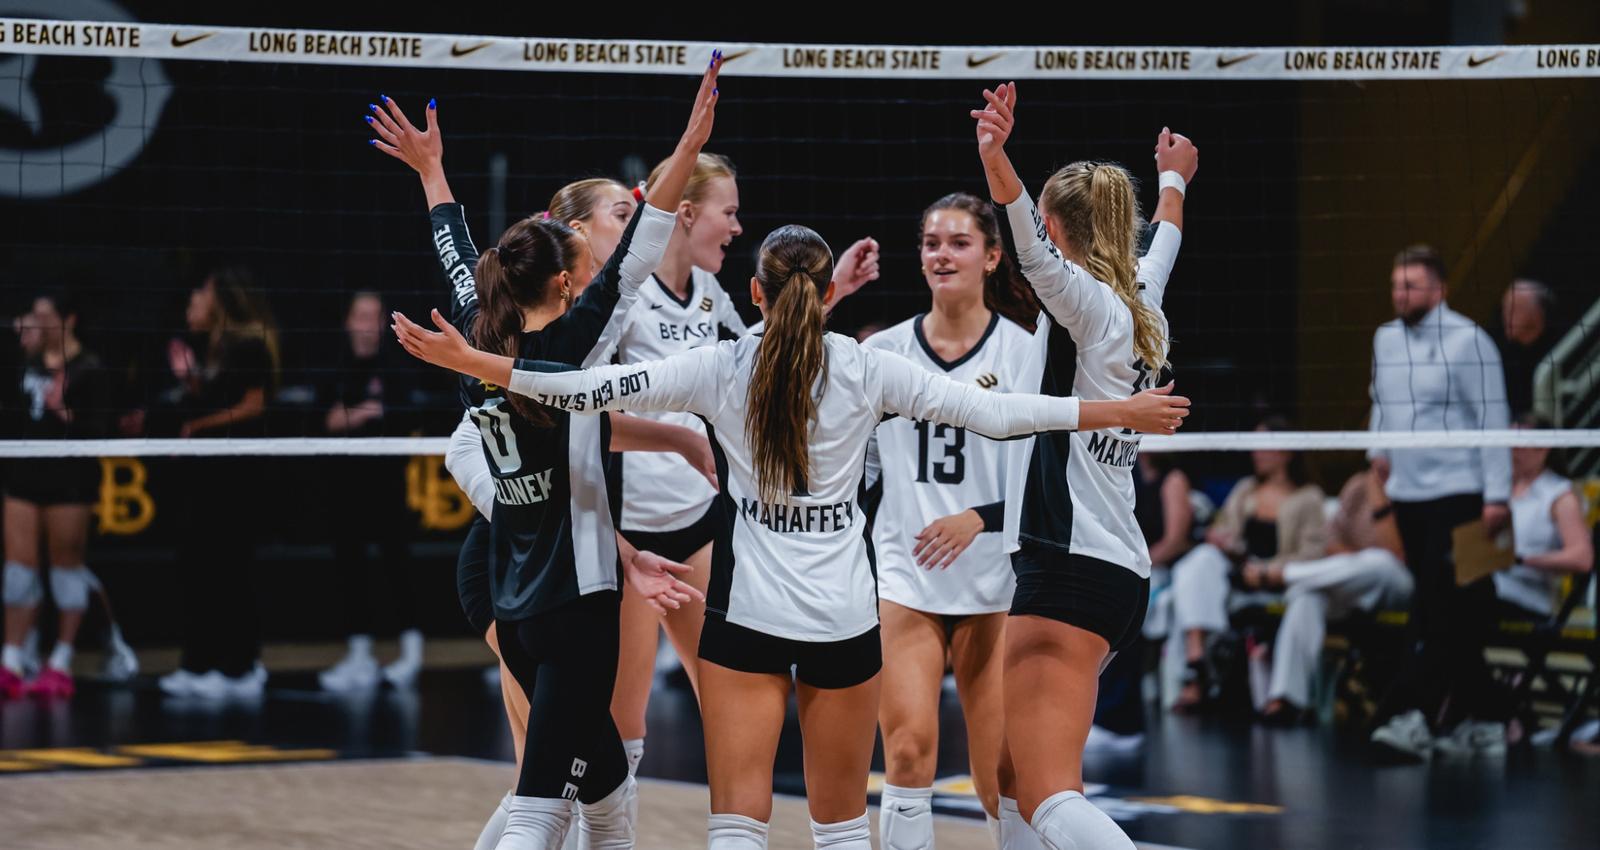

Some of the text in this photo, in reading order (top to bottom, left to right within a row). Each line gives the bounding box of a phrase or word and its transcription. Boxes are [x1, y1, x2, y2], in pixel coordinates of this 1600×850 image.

[13, 23, 75, 46] BEACH
[82, 26, 140, 48] STATE
[249, 32, 422, 58] LONG BEACH STATE
[523, 42, 686, 65] LONG BEACH STATE
[783, 48, 940, 70] LONG BEACH STATE
[1035, 51, 1191, 70] LONG BEACH STATE
[1284, 51, 1441, 70] LONG BEACH STATE
[1536, 49, 1580, 69] LONG
[914, 419, 965, 485] 13
